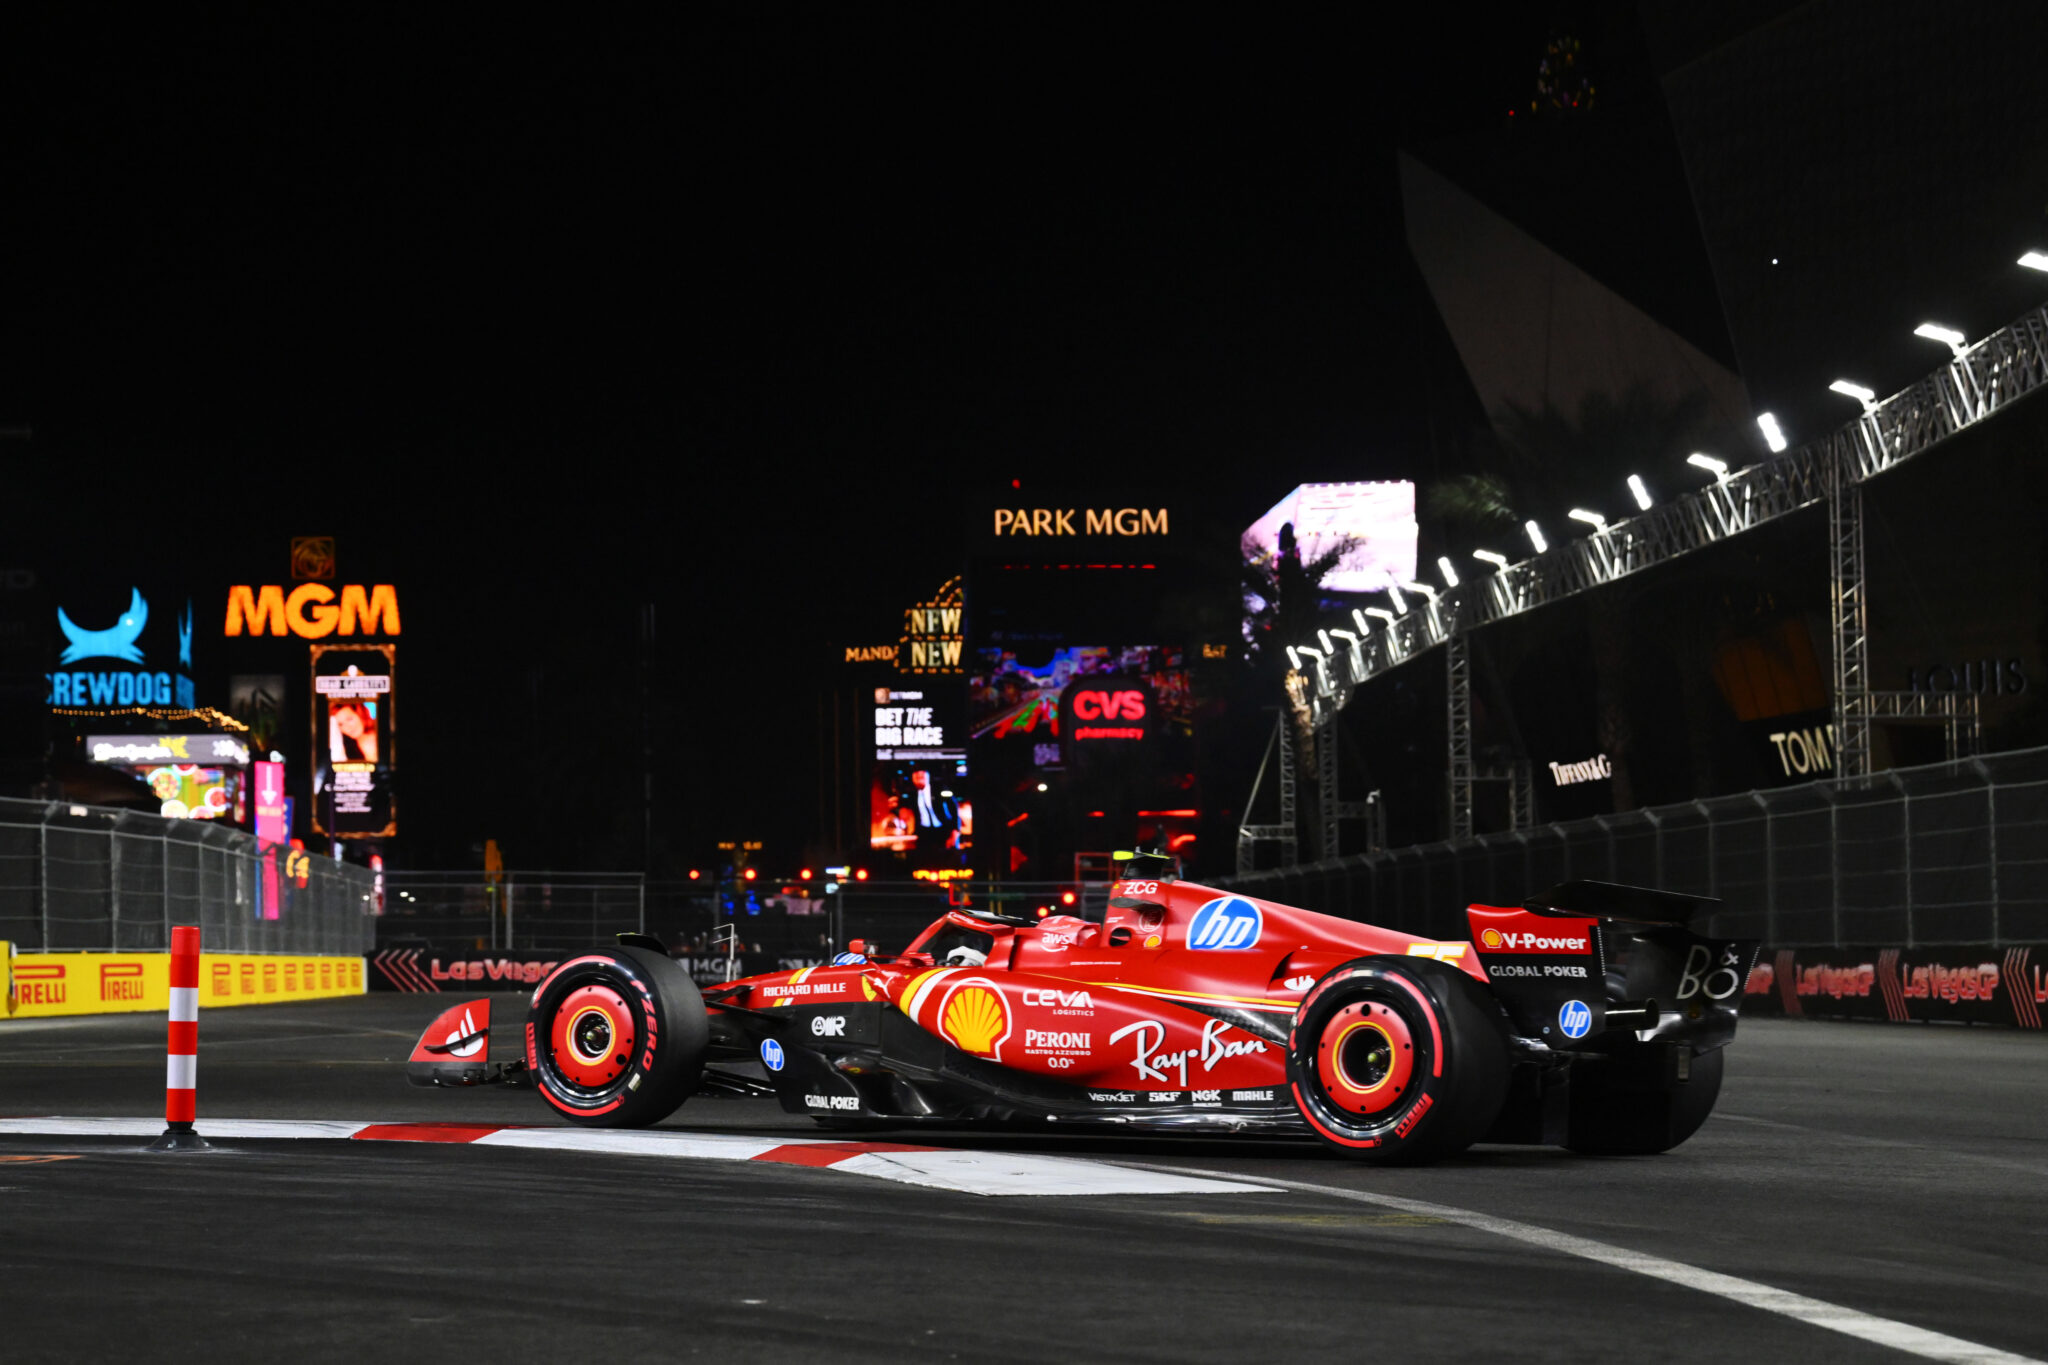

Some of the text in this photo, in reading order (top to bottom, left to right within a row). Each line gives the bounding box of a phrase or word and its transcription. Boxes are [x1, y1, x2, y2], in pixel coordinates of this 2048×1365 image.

[994, 508, 1169, 535] PARK MGM
[224, 582, 400, 639] MGM
[911, 608, 962, 634] NEW
[911, 641, 962, 666] NEW
[1073, 690, 1146, 720] CVS
[875, 707, 904, 726] BET
[1074, 727, 1144, 741] pharmacy
[1769, 726, 1832, 777] TOM
[1123, 882, 1158, 895] ZCG
[1192, 897, 1255, 949] hp
[1042, 932, 1071, 945] aws
[1502, 933, 1587, 950] V-Power
[1490, 965, 1588, 978] GLOBAL POKER
[100, 963, 143, 1001] PIRELLI
[763, 982, 846, 997] RICHARD MILLE
[1053, 1009, 1094, 1017] LOGISTICS
[1562, 1001, 1588, 1038] hp
[1025, 1029, 1091, 1049] PERONI
[763, 1039, 783, 1071] hp
[830, 1096, 860, 1110] POKER
[1149, 1092, 1181, 1102] SKF
[1192, 1090, 1222, 1102] NGK
[1232, 1090, 1274, 1102] MAHLE
